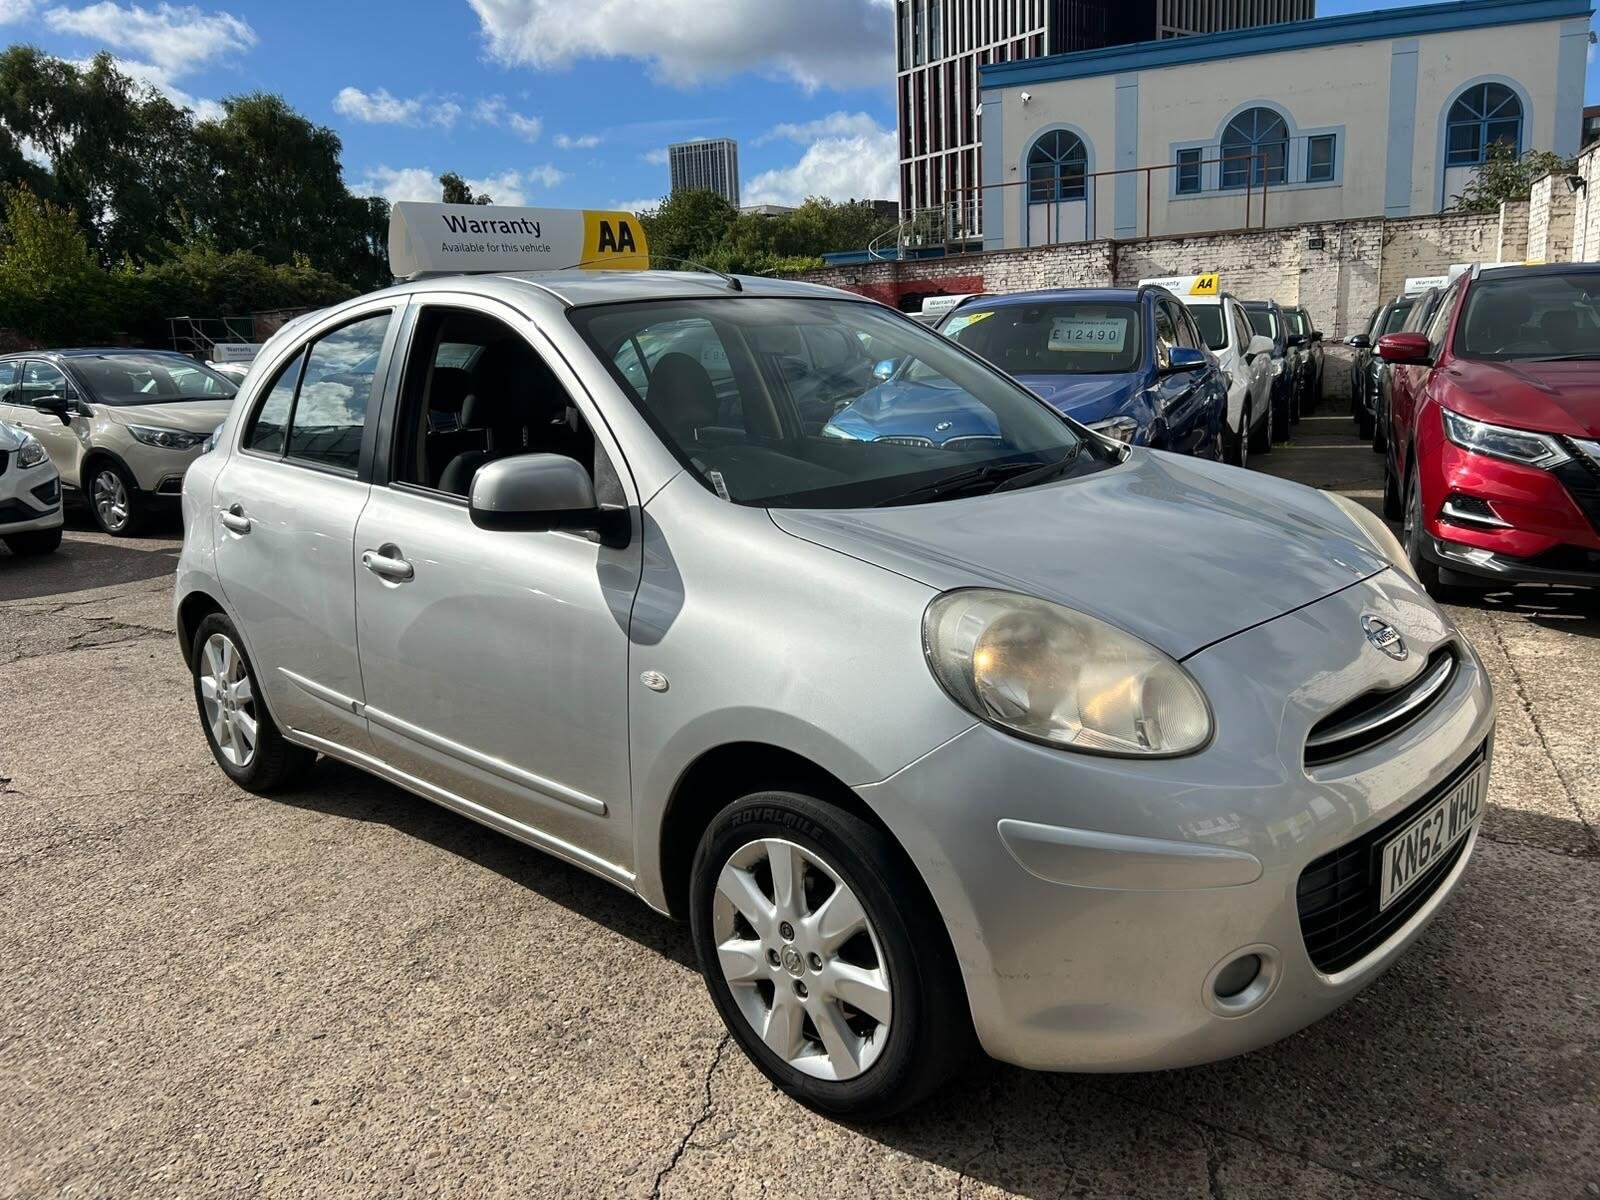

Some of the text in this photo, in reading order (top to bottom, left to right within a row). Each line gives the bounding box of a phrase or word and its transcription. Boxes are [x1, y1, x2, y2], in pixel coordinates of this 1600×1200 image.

[442, 215, 541, 238] Warranty
[598, 221, 636, 252] AA
[442, 242, 551, 253] Available for this vehicle
[1197, 279, 1213, 289] AA
[929, 298, 956, 306] Warranty
[1052, 329, 1117, 341] £12490
[1391, 772, 1480, 894] KN62 WHU
